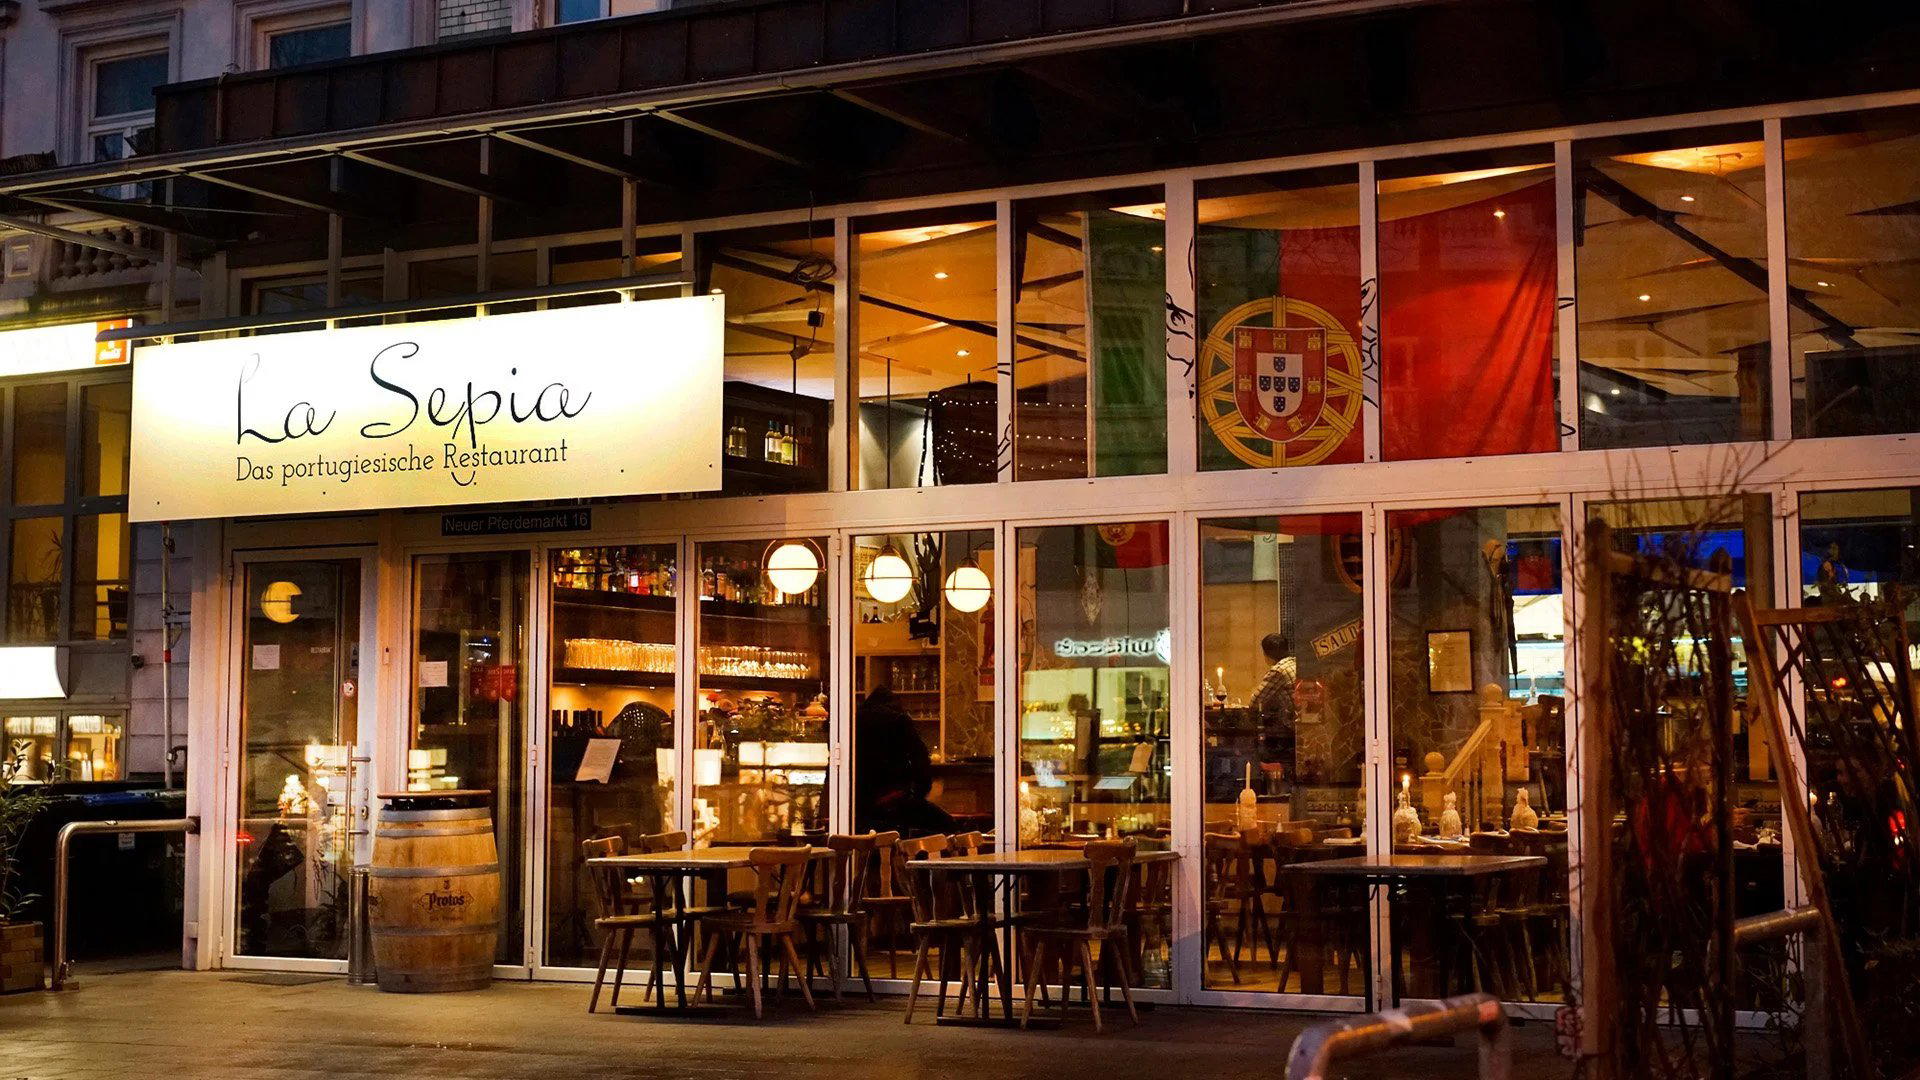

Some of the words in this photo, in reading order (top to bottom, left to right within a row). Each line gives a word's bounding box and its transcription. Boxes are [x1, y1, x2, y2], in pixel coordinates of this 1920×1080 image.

[236, 352, 337, 445] La
[360, 341, 593, 487] Sepia
[235, 456, 275, 482] Das
[281, 443, 435, 487] portugiesische
[443, 438, 569, 470] Restaurant
[445, 517, 484, 532] Neuer
[488, 513, 568, 530] Pferdemarkt
[573, 512, 588, 527] 16
[425, 892, 465, 911] Protos
